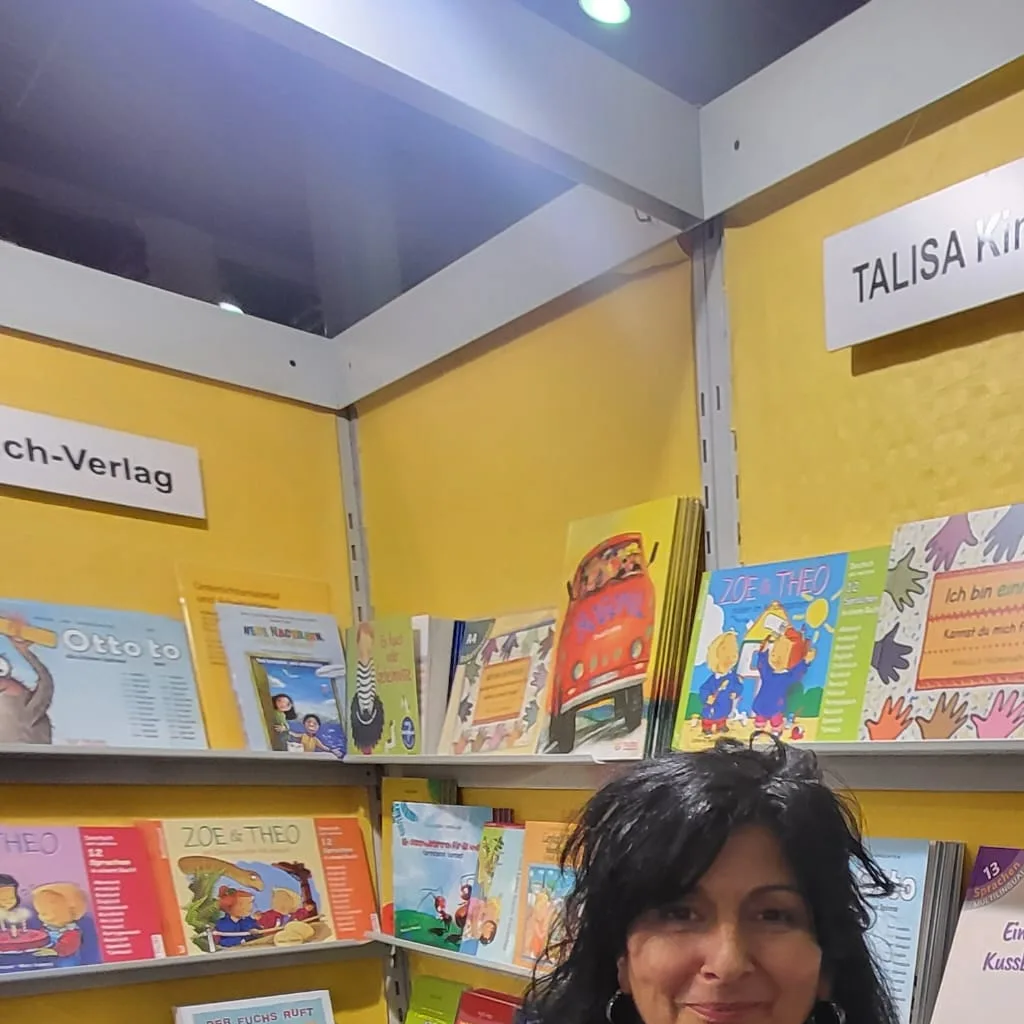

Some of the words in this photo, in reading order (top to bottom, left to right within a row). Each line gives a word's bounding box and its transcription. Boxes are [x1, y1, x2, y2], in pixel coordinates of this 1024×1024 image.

[852, 230, 966, 303] TALISA
[3, 438, 174, 494] ch-Verlag
[720, 573, 757, 605] ZOE
[775, 564, 831, 596] THEO
[945, 587, 966, 603] Ich
[970, 585, 992, 601] bin
[62, 628, 143, 657] Otto
[181, 826, 226, 848] ZOE
[246, 824, 300, 846] THEO
[973, 861, 1021, 898] Sprachen
[983, 861, 1001, 880] 13
[284, 1007, 314, 1019] RUFT
